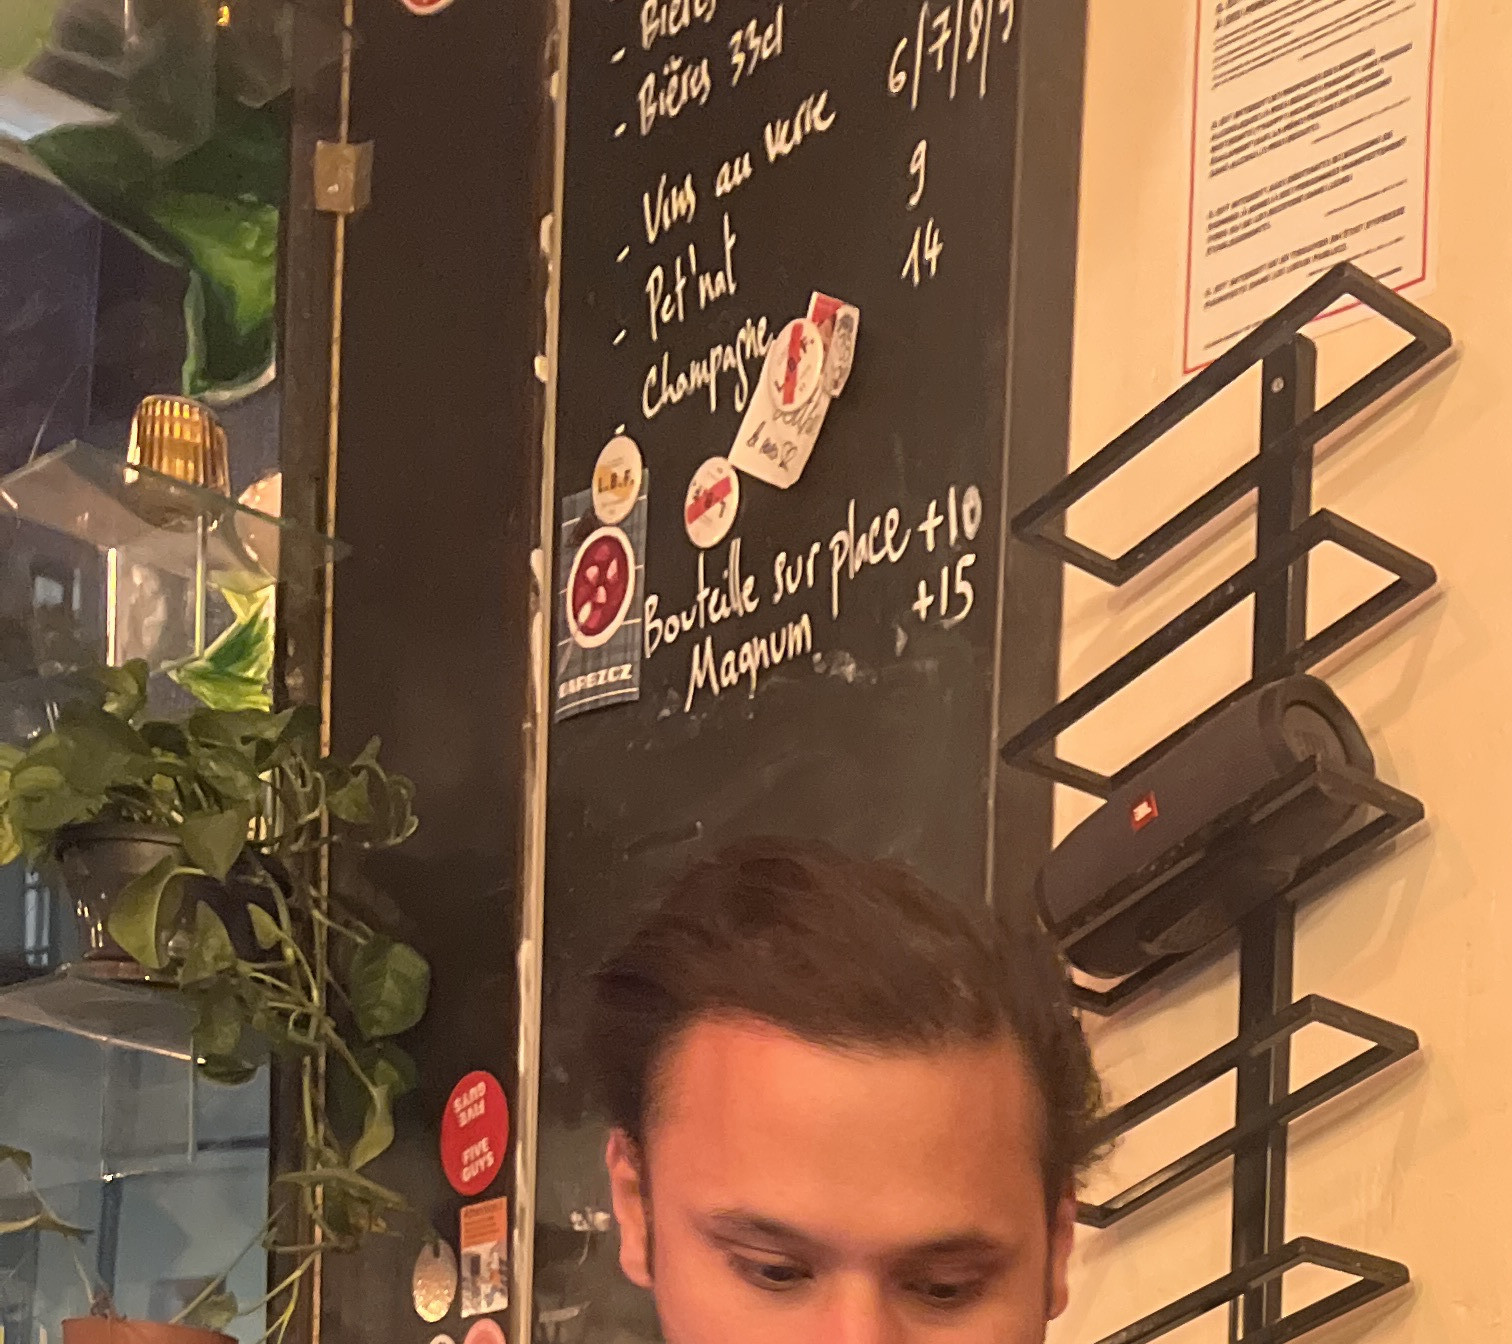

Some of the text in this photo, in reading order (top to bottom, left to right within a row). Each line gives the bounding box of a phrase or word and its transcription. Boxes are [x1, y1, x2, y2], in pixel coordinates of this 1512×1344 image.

[715, 152, 753, 198] au
[764, 89, 837, 163] verre
[908, 139, 927, 208] 9
[901, 217, 943, 287] 14
[642, 315, 774, 419] Champagne
[643, 484, 983, 659] Bouteille sur place +10
[911, 552, 977, 630] +15
[684, 611, 813, 714] Magnum
